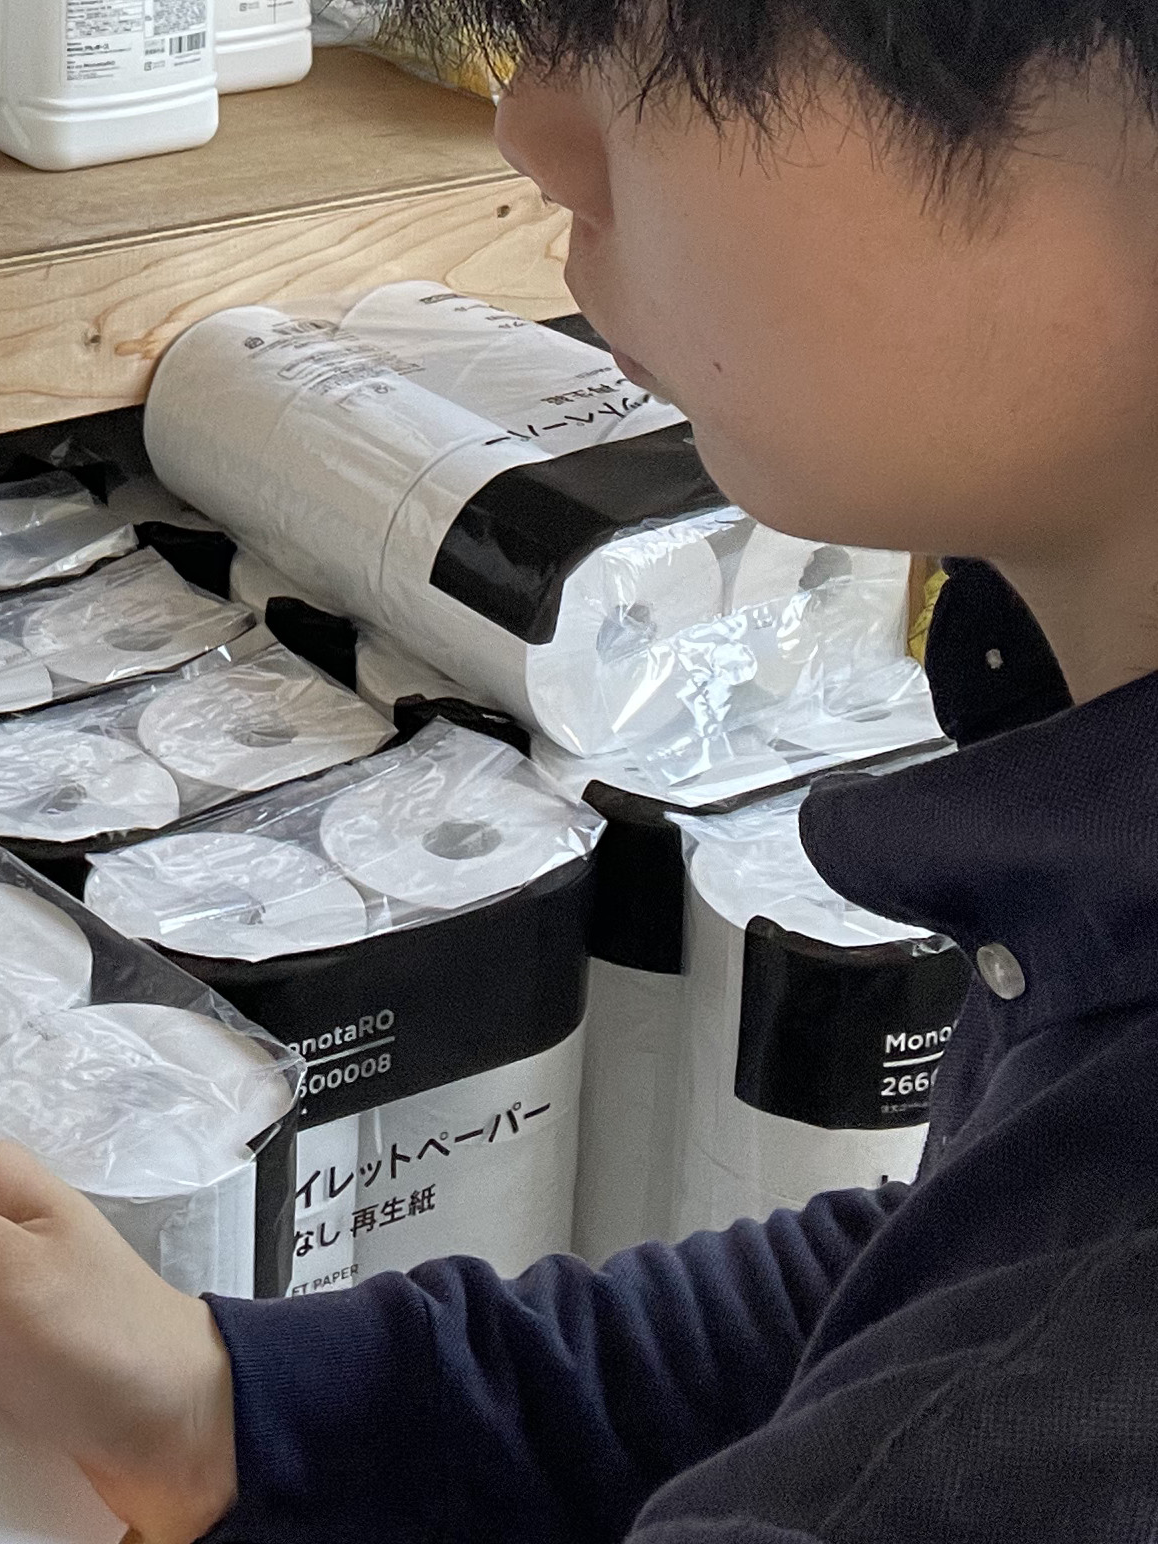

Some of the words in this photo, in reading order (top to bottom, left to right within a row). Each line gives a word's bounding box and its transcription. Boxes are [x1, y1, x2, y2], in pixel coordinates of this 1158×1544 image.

[485, 394, 652, 447] ットペーパー
[288, 1009, 395, 1056] onotaRO
[885, 1019, 959, 1053] Mono
[295, 1102, 551, 1208] イレットペーパー
[294, 1222, 340, 1257] なし
[349, 1183, 436, 1238] 再生紙
[313, 1264, 359, 1290] PAPER
